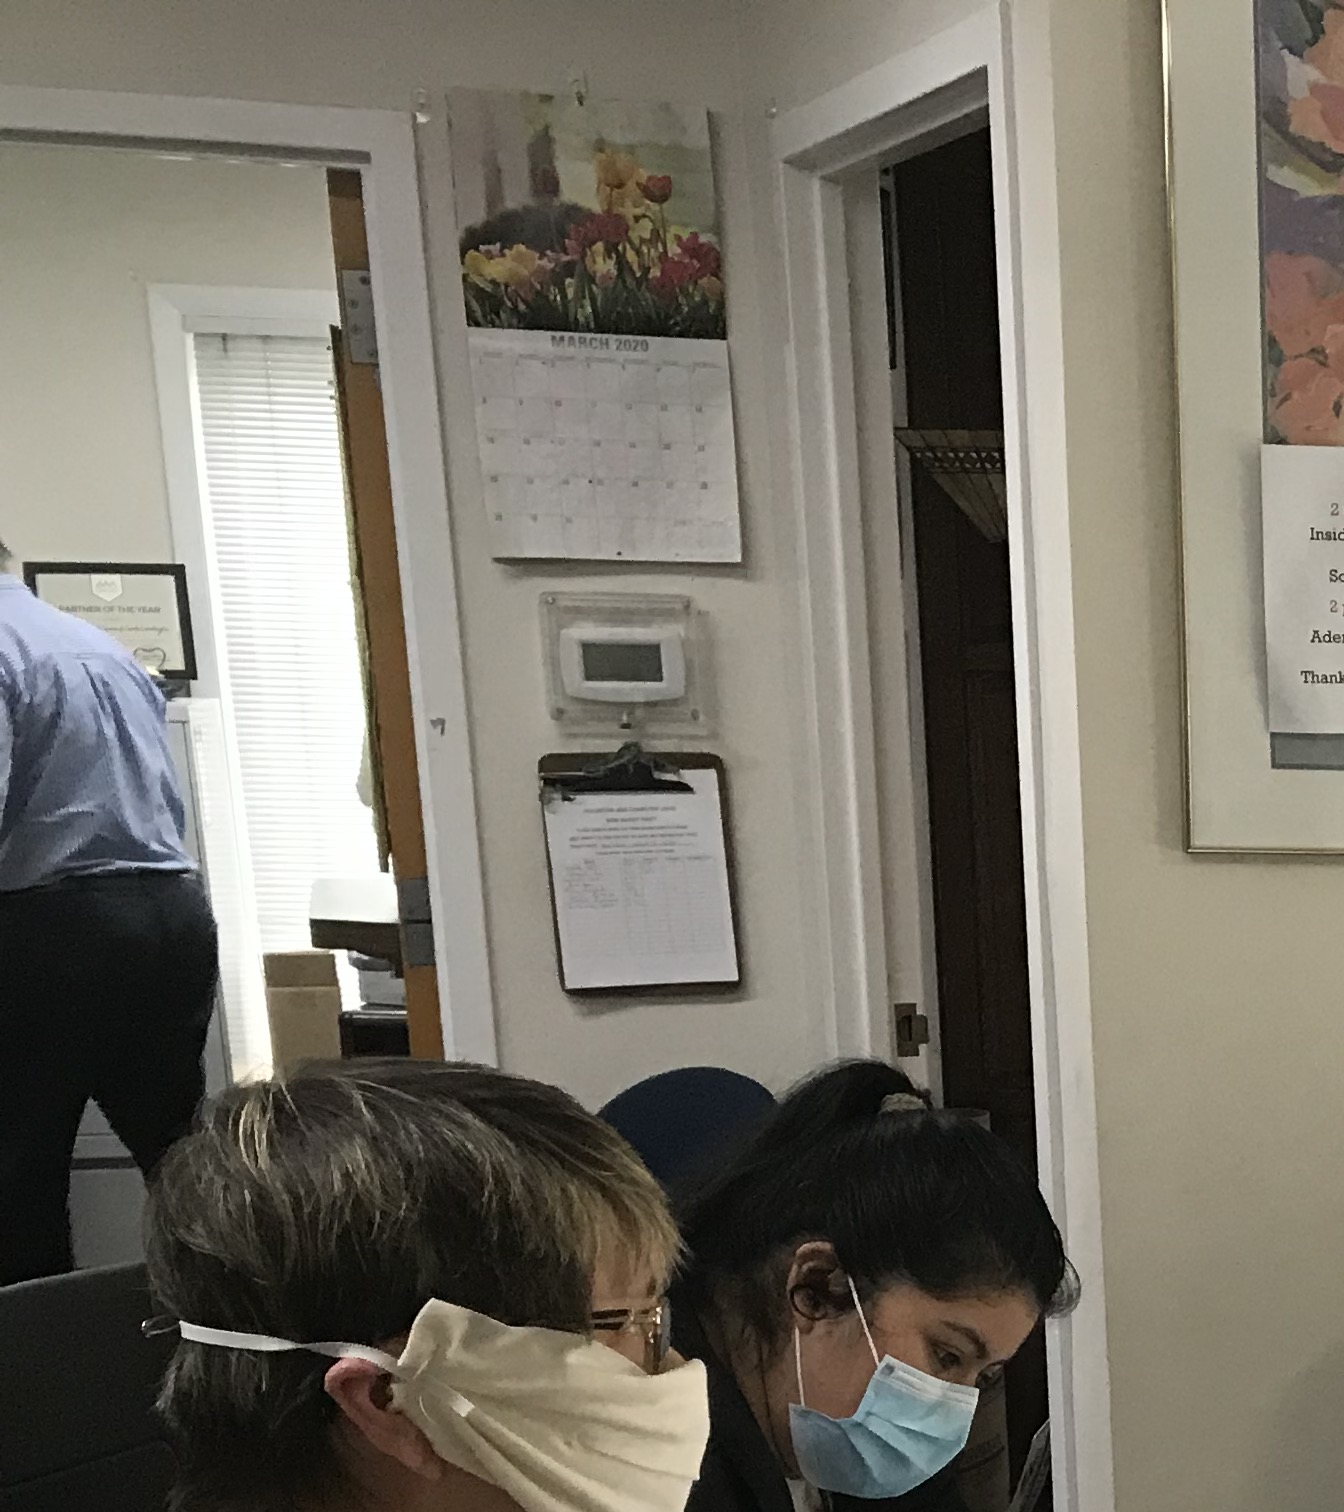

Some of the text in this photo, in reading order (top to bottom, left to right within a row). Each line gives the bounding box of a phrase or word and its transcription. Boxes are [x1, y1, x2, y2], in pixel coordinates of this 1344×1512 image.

[551, 335, 649, 352] MARCH 2020
[1330, 503, 1340, 518] 2
[1329, 601, 1339, 615] 2
